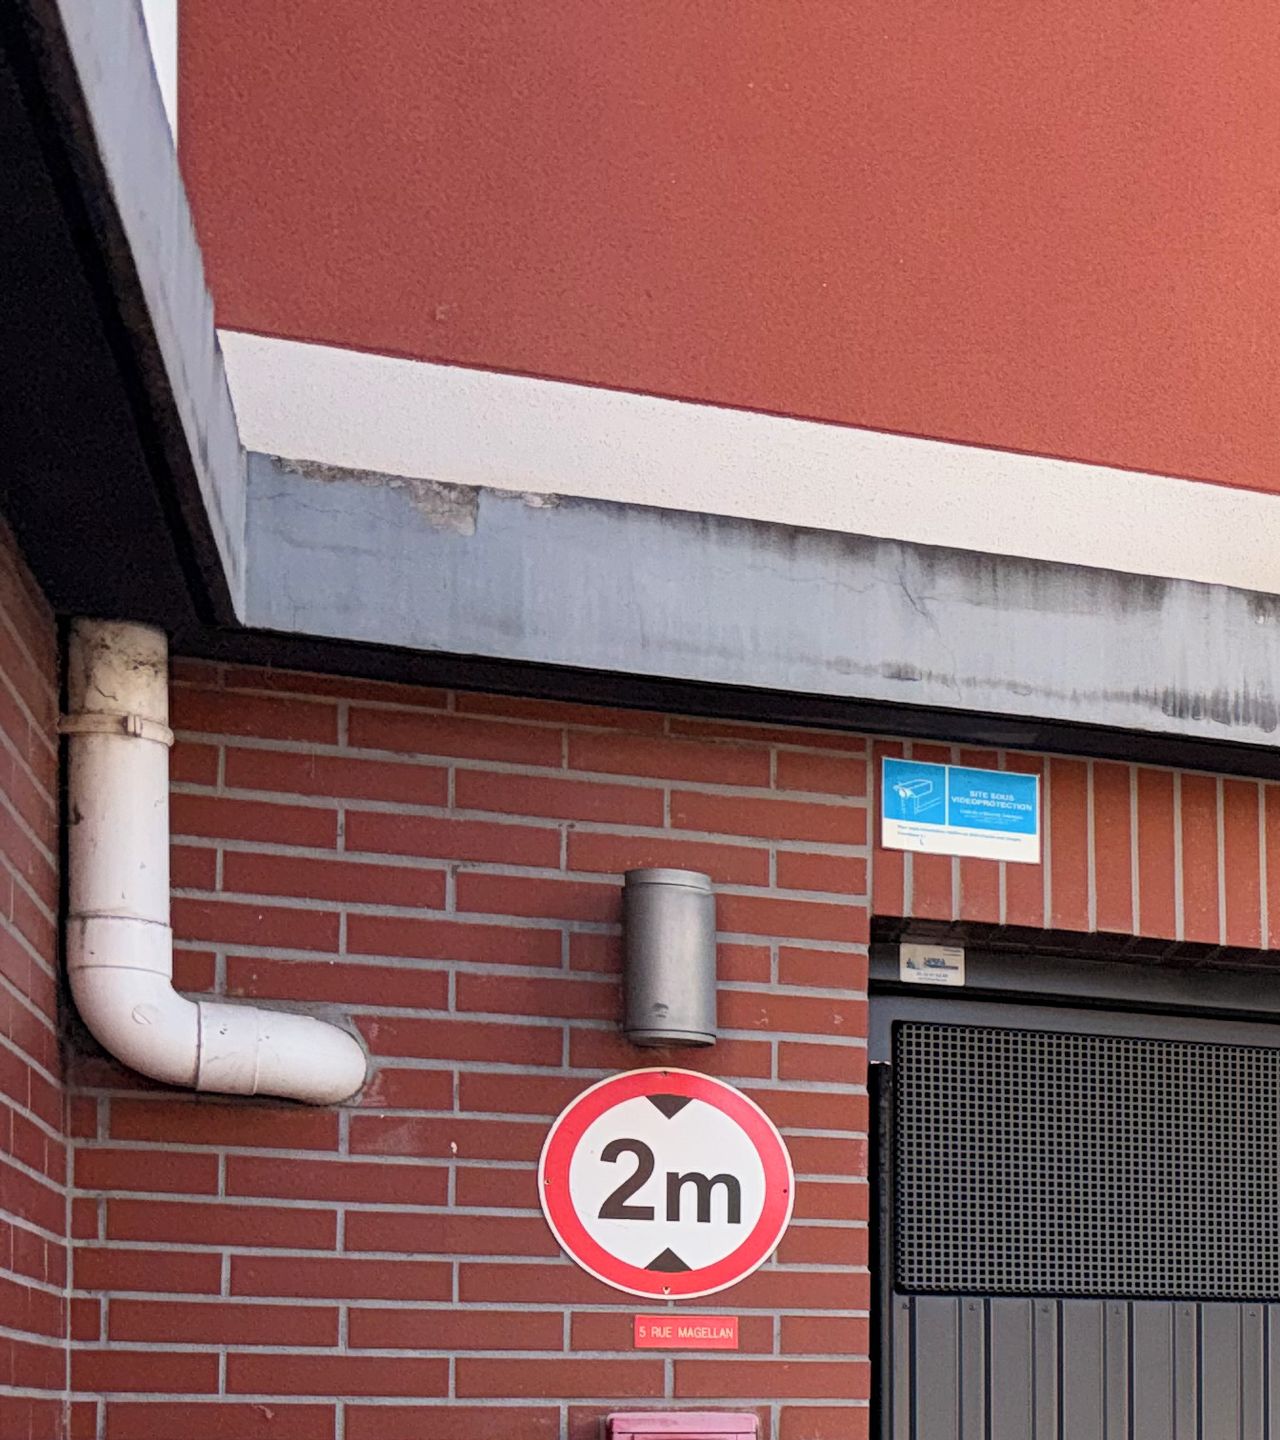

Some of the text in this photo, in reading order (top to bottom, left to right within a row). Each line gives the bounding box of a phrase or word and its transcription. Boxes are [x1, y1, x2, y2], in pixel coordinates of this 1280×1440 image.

[969, 790, 1015, 802] SITE SOUS
[598, 1138, 741, 1224] 2m
[639, 1326, 733, 1338] 5 RUE MAGELLAN
